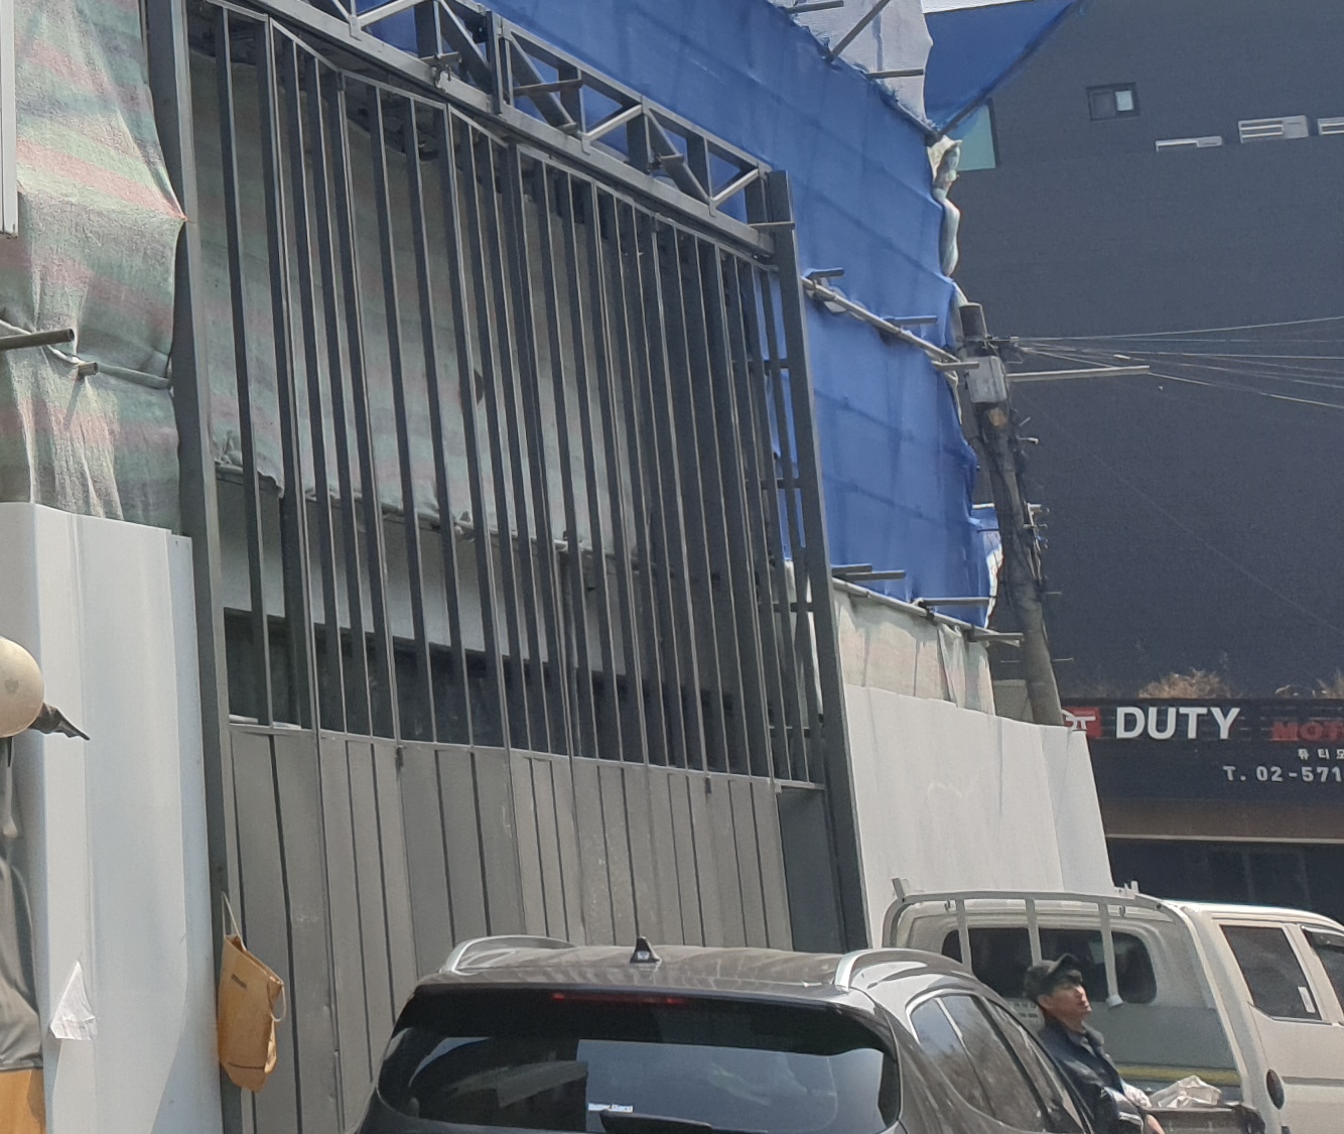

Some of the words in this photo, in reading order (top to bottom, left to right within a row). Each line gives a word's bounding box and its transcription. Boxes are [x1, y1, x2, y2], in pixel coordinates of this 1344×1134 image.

[1116, 707, 1240, 739] DUTY
[1223, 766, 1246, 781] T.
[1256, 765, 1342, 782] 02-571
